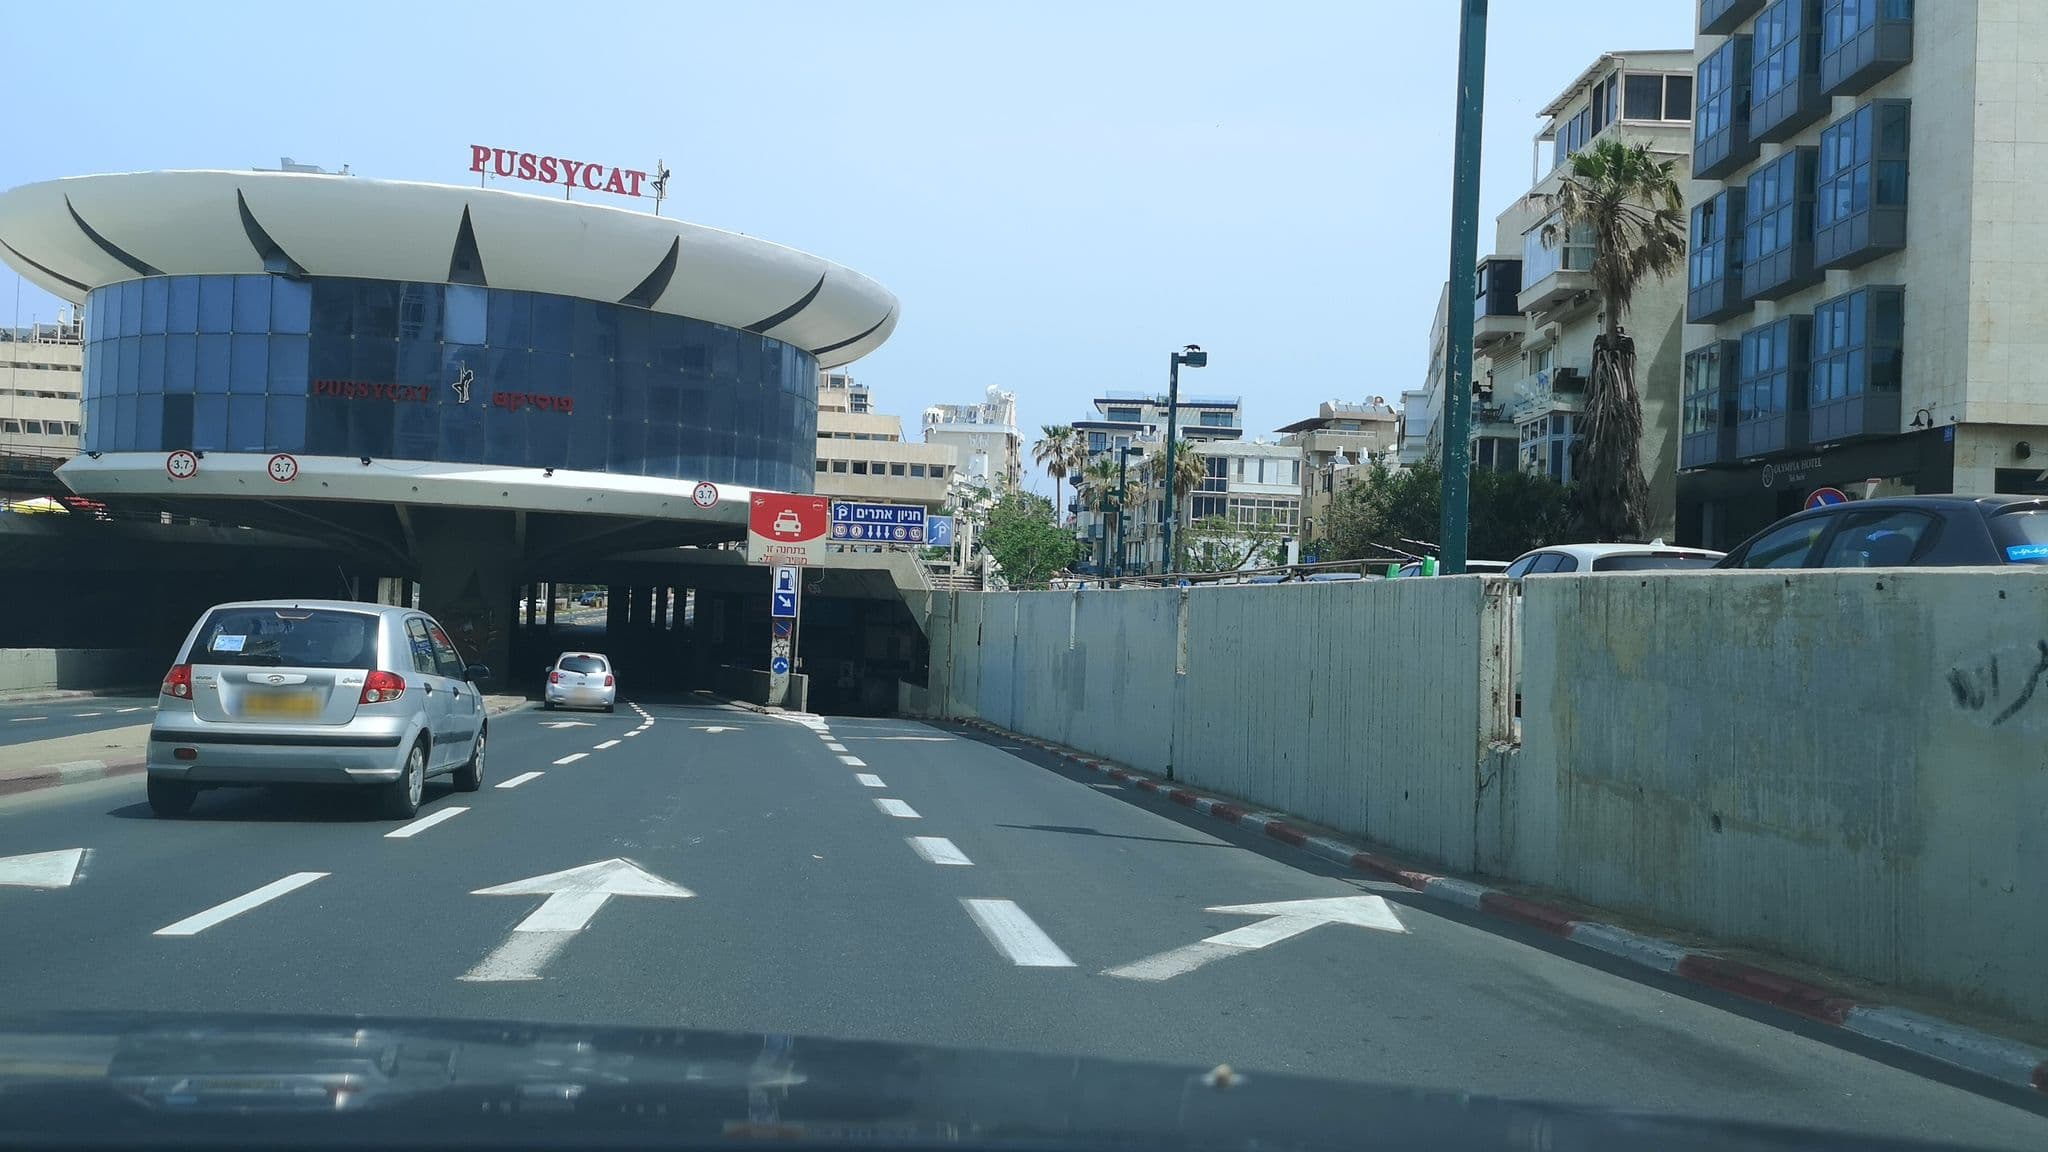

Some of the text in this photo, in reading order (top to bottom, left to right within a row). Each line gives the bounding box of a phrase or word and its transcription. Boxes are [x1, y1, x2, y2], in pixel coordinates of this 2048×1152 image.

[469, 144, 646, 197] PUSSYCAT
[313, 379, 430, 402] PUSSYCAT
[173, 460, 190, 470] 3.7
[275, 463, 291, 473] 3.7
[698, 490, 713, 499] 3.7
[856, 508, 921, 523] חניון אתרים
[776, 546, 806, 555] בתחנה
